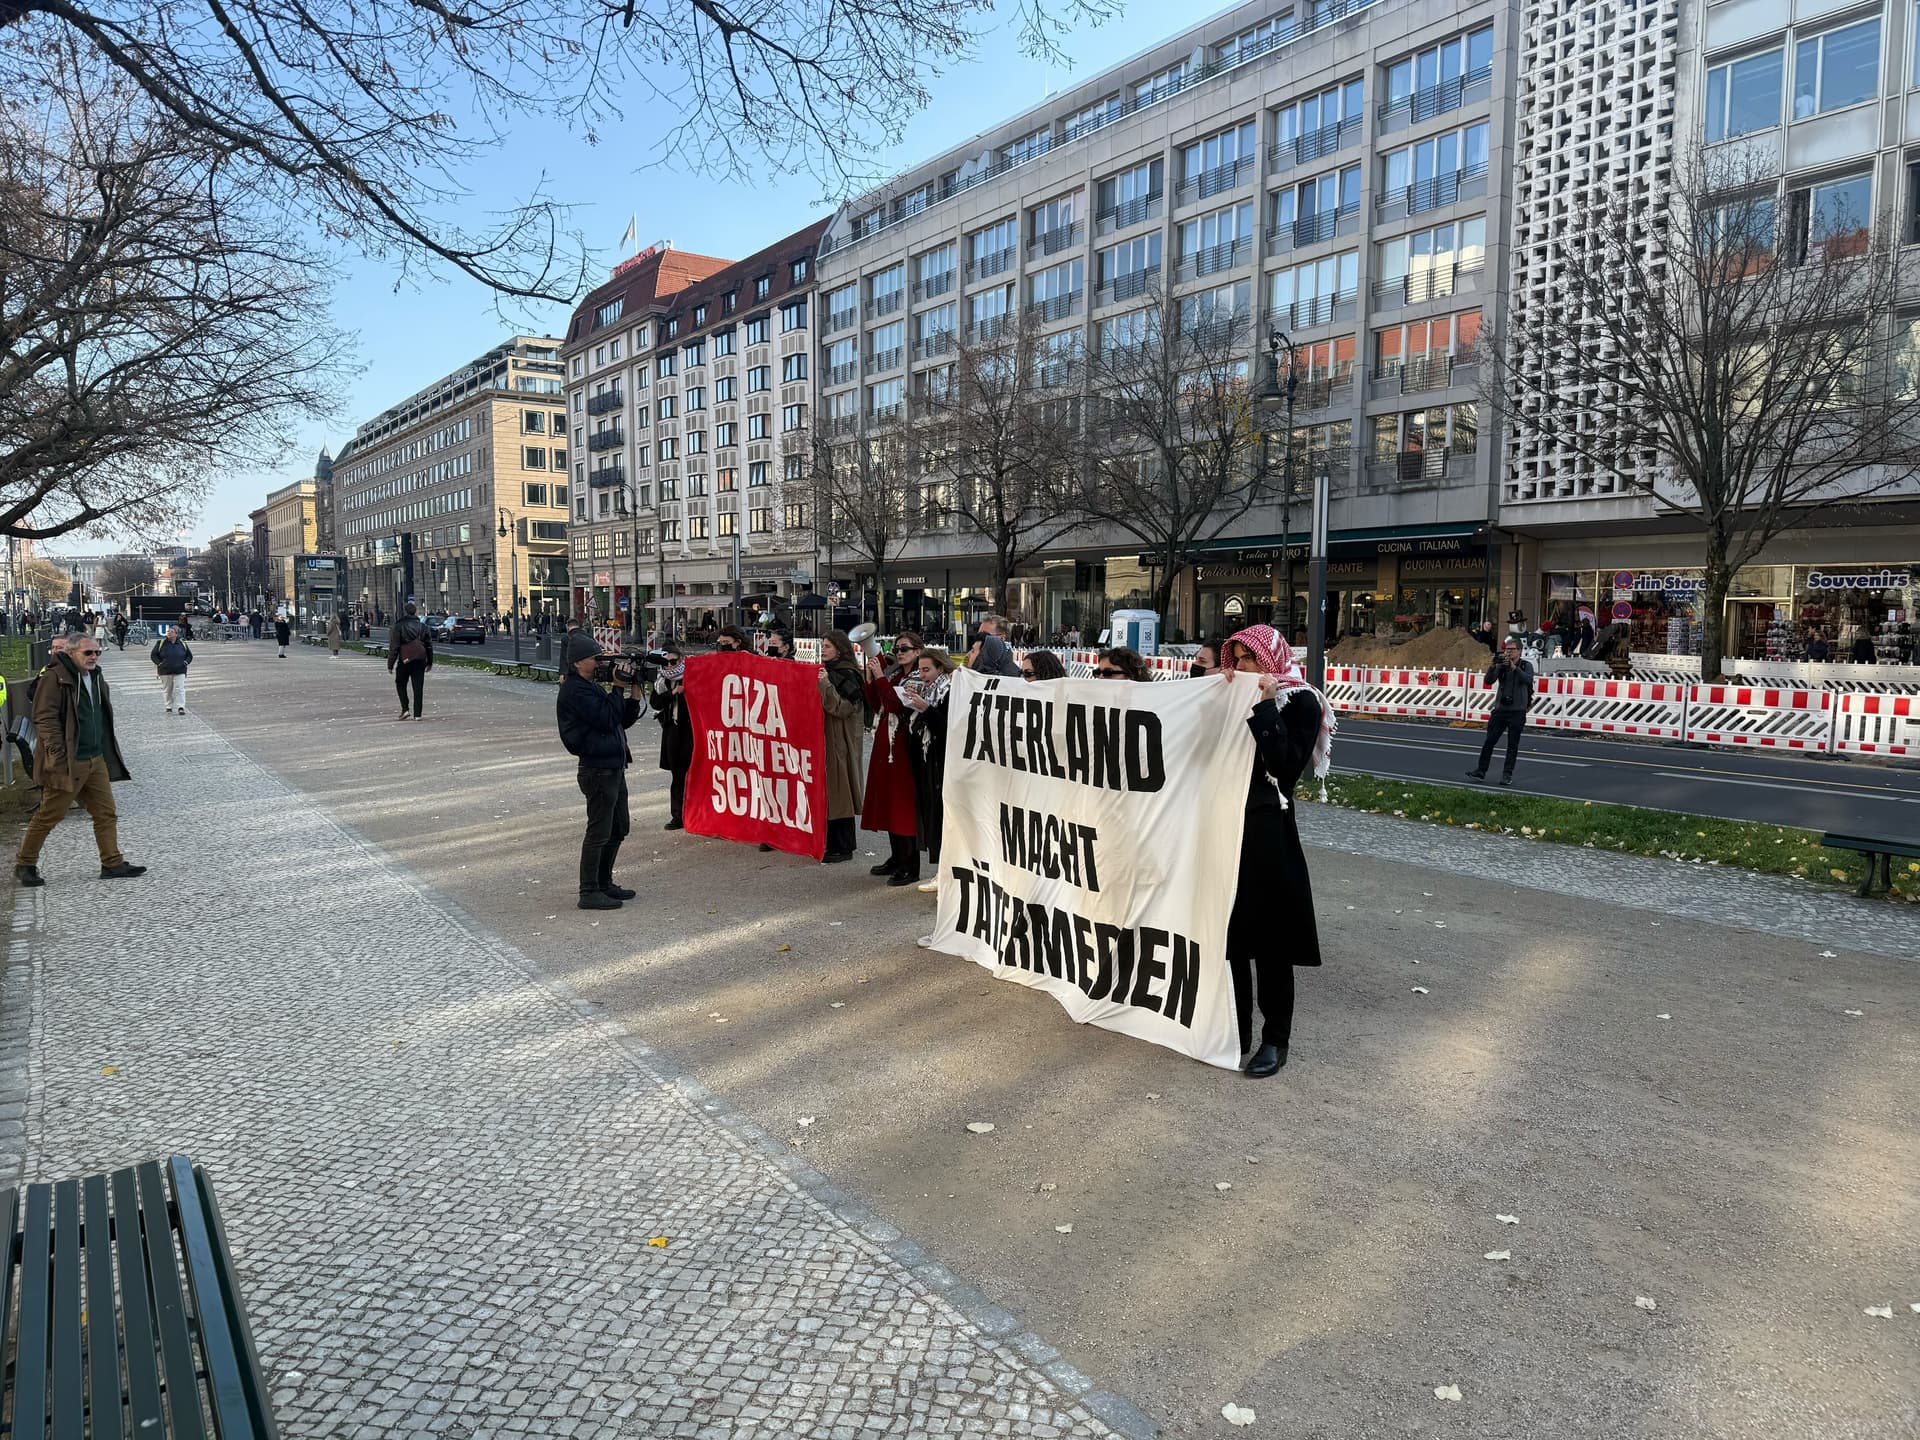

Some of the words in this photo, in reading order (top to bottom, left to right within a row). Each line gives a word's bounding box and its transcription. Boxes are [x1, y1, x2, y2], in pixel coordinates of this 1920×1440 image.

[1377, 543, 1412, 553] CUCINA
[1419, 540, 1460, 551] ITALIANA
[1405, 559, 1442, 570] CUCINA
[897, 576, 926, 585] STARBUCKS
[1613, 575, 1662, 591] rlin
[1808, 569, 1910, 588] Souvenirs
[963, 678, 1166, 793] TÄTERLAND
[707, 730, 724, 761] IST
[1000, 802, 1100, 893] MACHT
[952, 857, 1200, 1030] TÄTERMEDIEN
